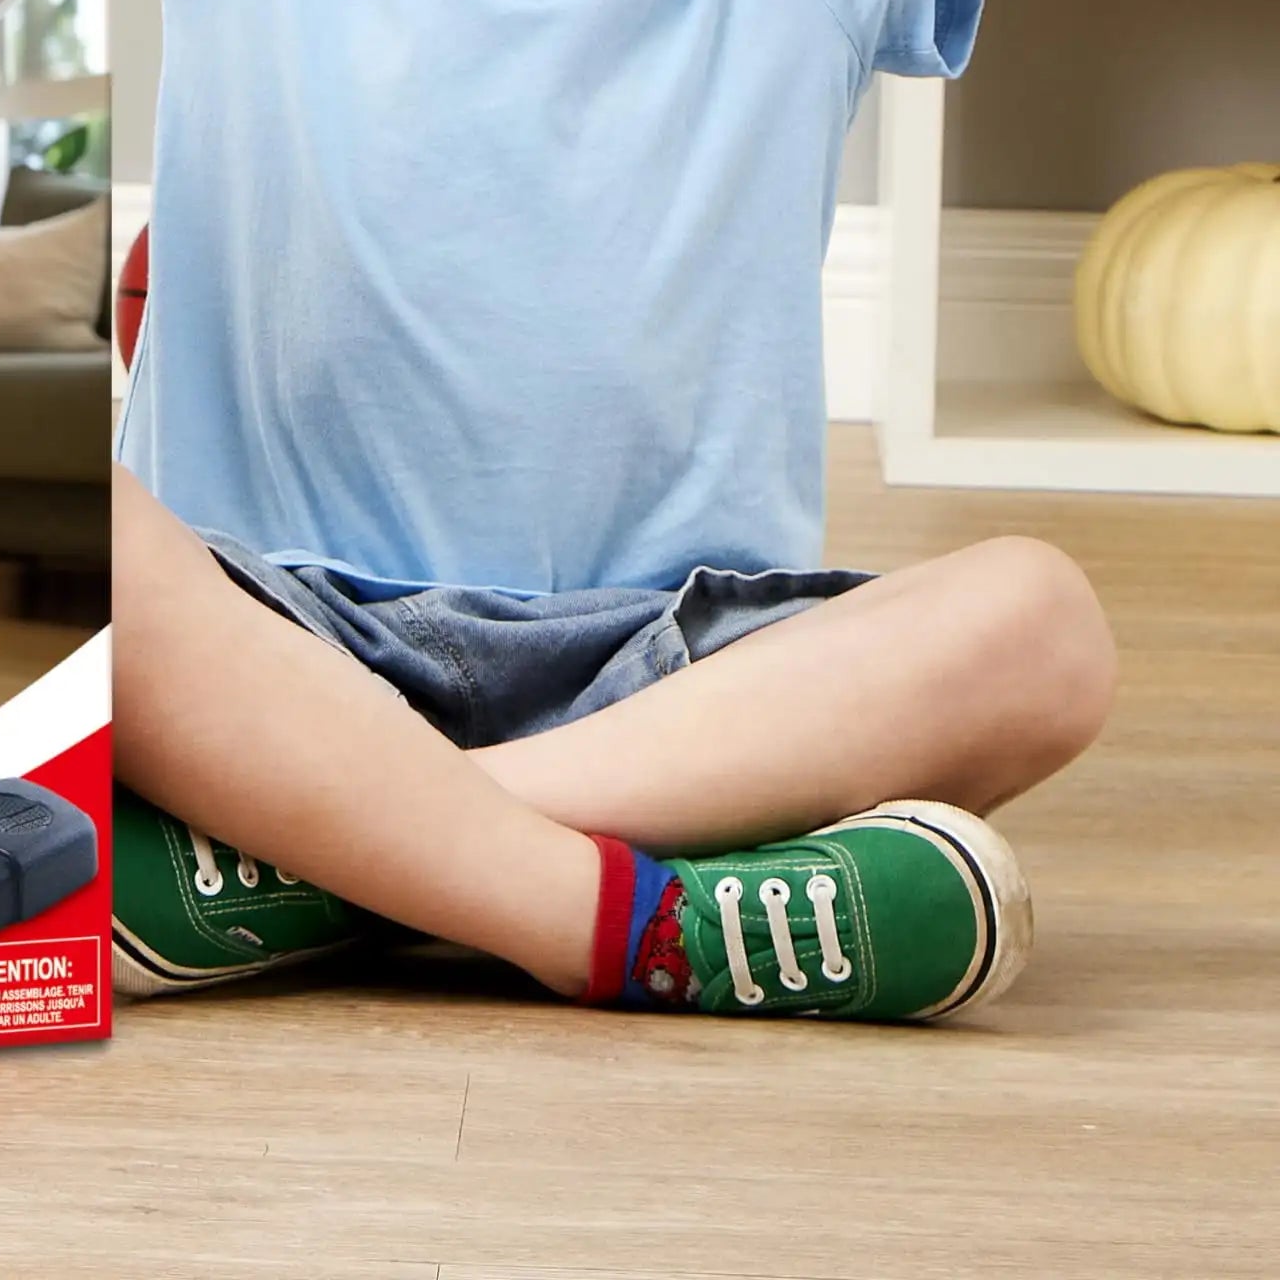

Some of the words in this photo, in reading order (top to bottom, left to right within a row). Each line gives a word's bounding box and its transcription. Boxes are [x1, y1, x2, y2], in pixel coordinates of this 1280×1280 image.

[67, 984, 94, 996] TENIR
[12, 1014, 25, 1025] UN
[26, 1011, 64, 1024] ADULTE.
